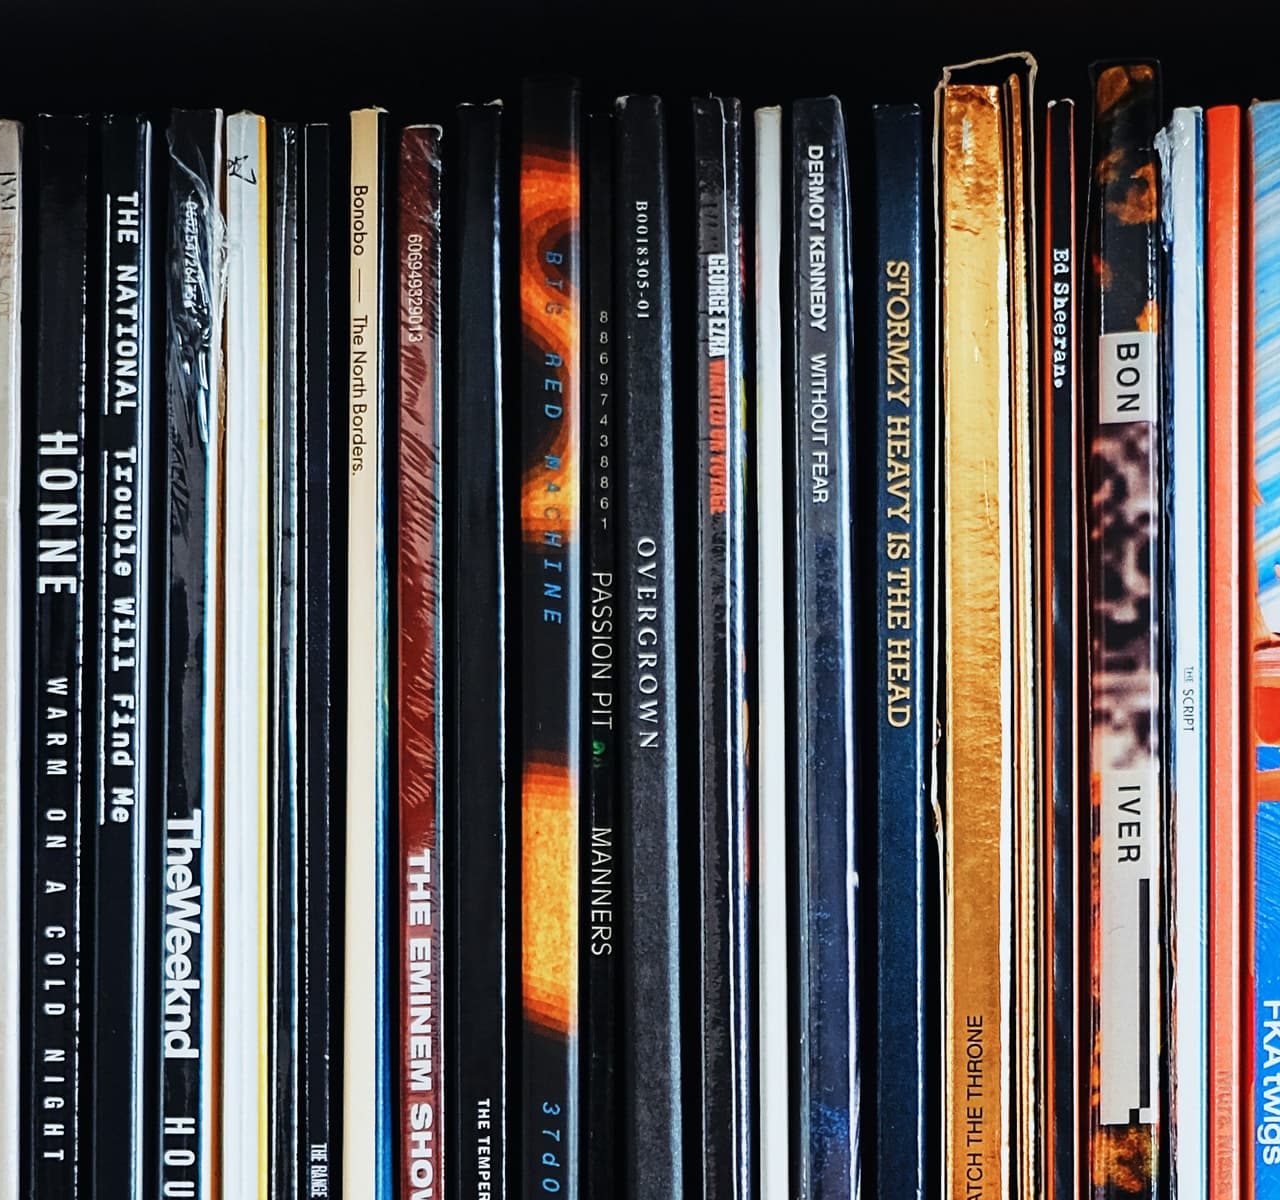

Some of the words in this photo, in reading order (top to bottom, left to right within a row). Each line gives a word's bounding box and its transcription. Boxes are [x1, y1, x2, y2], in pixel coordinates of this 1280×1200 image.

[118, 193, 138, 242] THE
[353, 185, 368, 255] Bonobo
[808, 145, 824, 232] DERMOT
[810, 236, 826, 331] KENNEDY
[1054, 248, 1070, 274] Ed
[116, 265, 138, 414] NATIONAL
[353, 315, 368, 345] The
[887, 261, 910, 407] STORMZY
[353, 352, 367, 398] North
[811, 354, 827, 445] WITHOUT
[1116, 343, 1140, 412] BON
[353, 404, 367, 476] Borders.
[888, 416, 910, 523] HEAVY
[38, 431, 78, 593] HONNE
[812, 451, 828, 504] FEAR
[888, 533, 910, 559] IS
[592, 573, 612, 678] PASSION
[888, 567, 910, 630] THE
[638, 537, 658, 747] OVERGROWN
[592, 693, 612, 730] PIT
[888, 639, 910, 727] HEAD
[592, 827, 611, 955] MANNERS
[478, 1098, 490, 1129] THE
[311, 1143, 327, 1161] THE
[311, 1165, 327, 1197] RANGE
